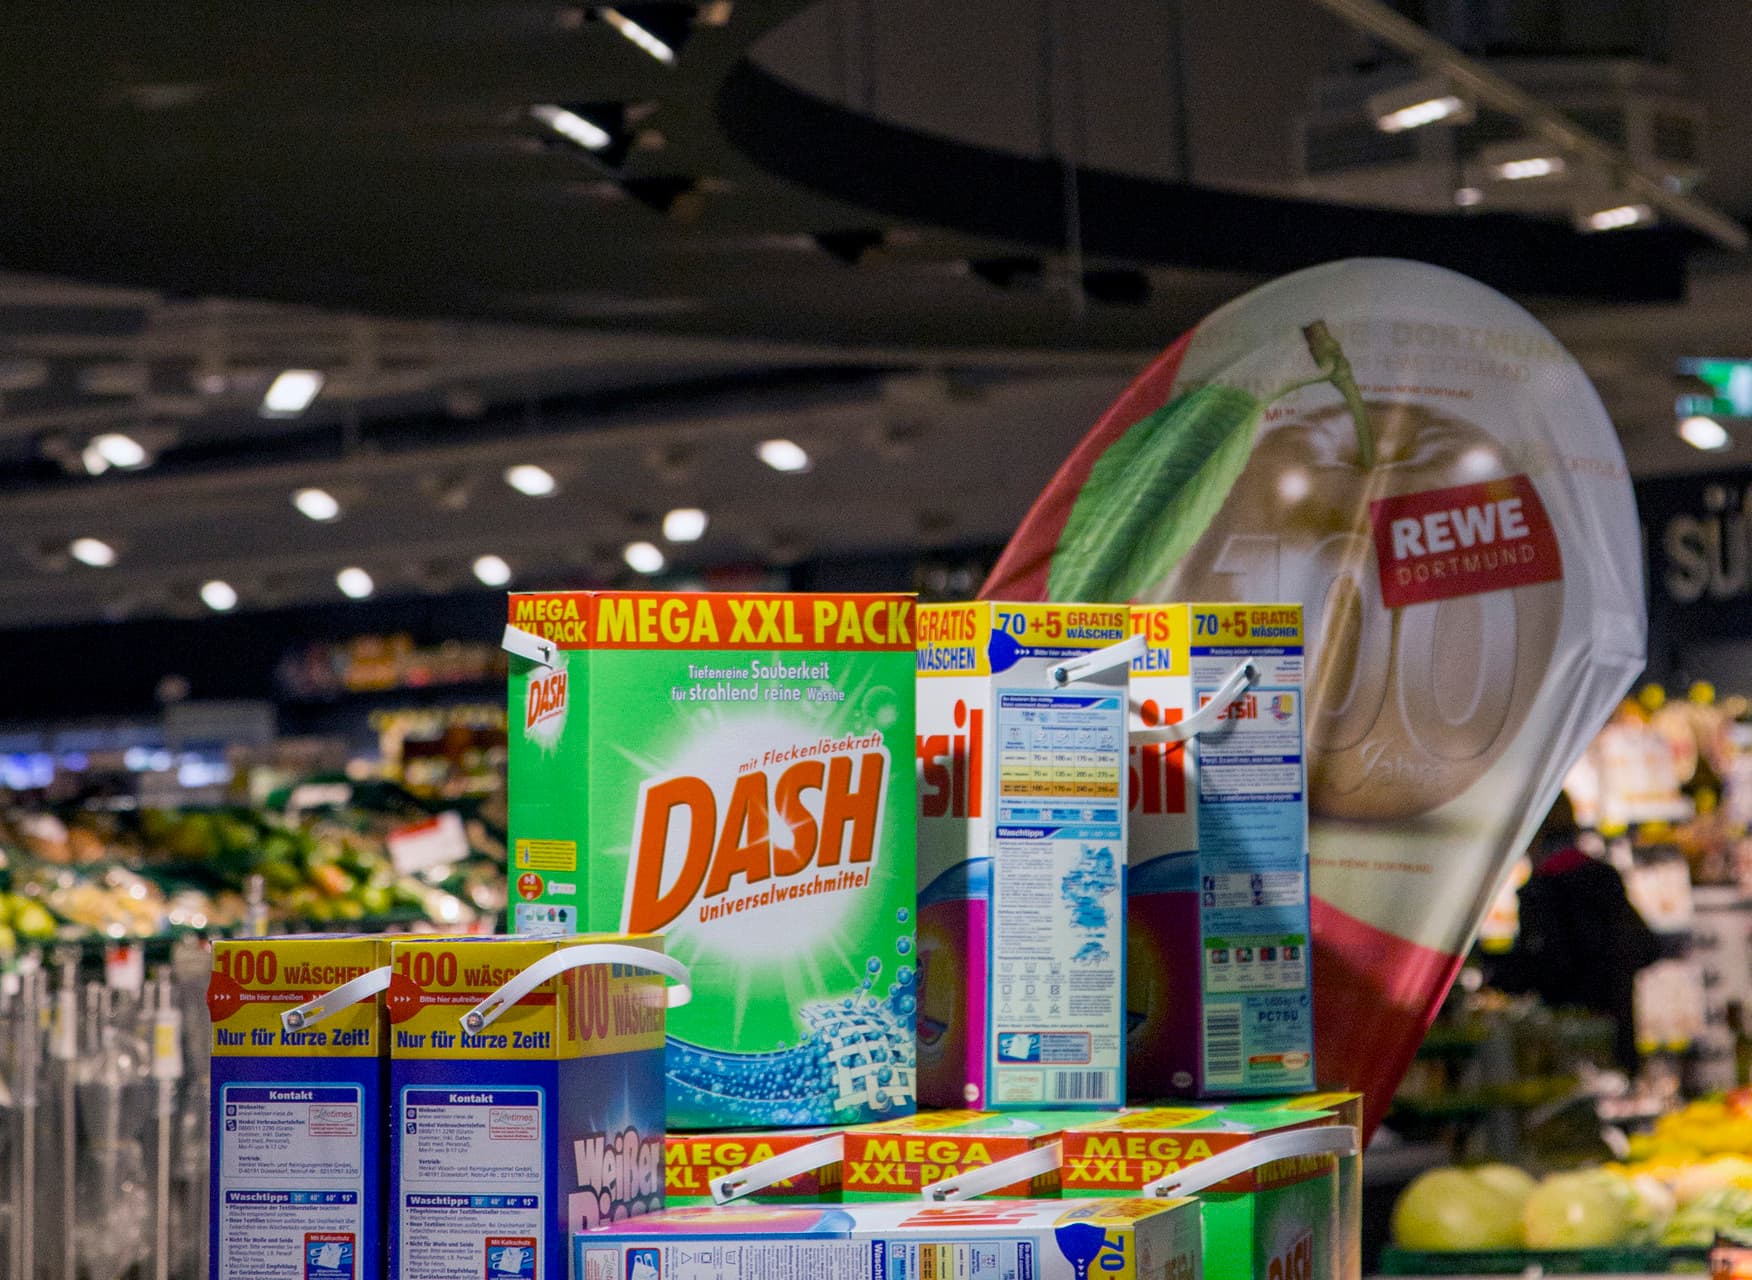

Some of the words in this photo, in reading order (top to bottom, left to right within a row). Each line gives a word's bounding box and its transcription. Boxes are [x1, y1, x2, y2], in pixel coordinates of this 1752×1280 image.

[1390, 498, 1530, 562] REWE
[1662, 484, 1752, 601] SÜ
[1398, 543, 1536, 586] DORTMUND
[516, 599, 579, 621] MEGA
[597, 599, 719, 643] MEGA
[727, 600, 802, 643] XXL
[814, 600, 912, 644] PACK
[1067, 612, 1123, 627] GRATIS
[1252, 611, 1298, 625] GRATIS
[544, 621, 587, 642] PACK
[918, 609, 976, 642] GRATIS
[1066, 627, 1123, 640] WÄSCHEN
[1130, 611, 1169, 642] TIS
[1251, 625, 1298, 638] WÄSCHEN
[688, 665, 749, 680] Tiefenreine
[751, 660, 830, 680] Sauberkeit
[917, 646, 976, 671] WÄSCHEN
[527, 673, 567, 729] DASH
[672, 687, 686, 701] für
[690, 683, 759, 701] strahlend
[764, 684, 801, 701] reine
[738, 758, 758, 774] mit
[762, 732, 882, 767] Fleckenlösekraft
[628, 753, 884, 934] DASH
[700, 867, 870, 923] Universalwaschmittel
[216, 949, 277, 985] 100
[284, 963, 370, 985] WÄSCHE
[396, 951, 457, 987] 100
[217, 1028, 246, 1046] Nur
[251, 1028, 276, 1046] für
[281, 1028, 327, 1046] kurze
[332, 1028, 370, 1046] Zeit!
[397, 1031, 426, 1048] Nur
[431, 1031, 456, 1048] für
[461, 1031, 508, 1048] kurze
[513, 1031, 550, 1049] Zeit!
[269, 1091, 313, 1100] Kontakt
[449, 1093, 494, 1103] Kontakt
[665, 1143, 776, 1166] MEGA
[863, 1139, 992, 1164] MEGA
[1083, 1137, 1215, 1160] MEGA
[574, 1130, 660, 1202] Weißer
[665, 1166, 700, 1188] XL
[848, 1162, 912, 1185] XXL
[1068, 1159, 1134, 1182] XXL
[230, 1192, 289, 1202] Waschtipps
[410, 1196, 469, 1206] Waschtipps
